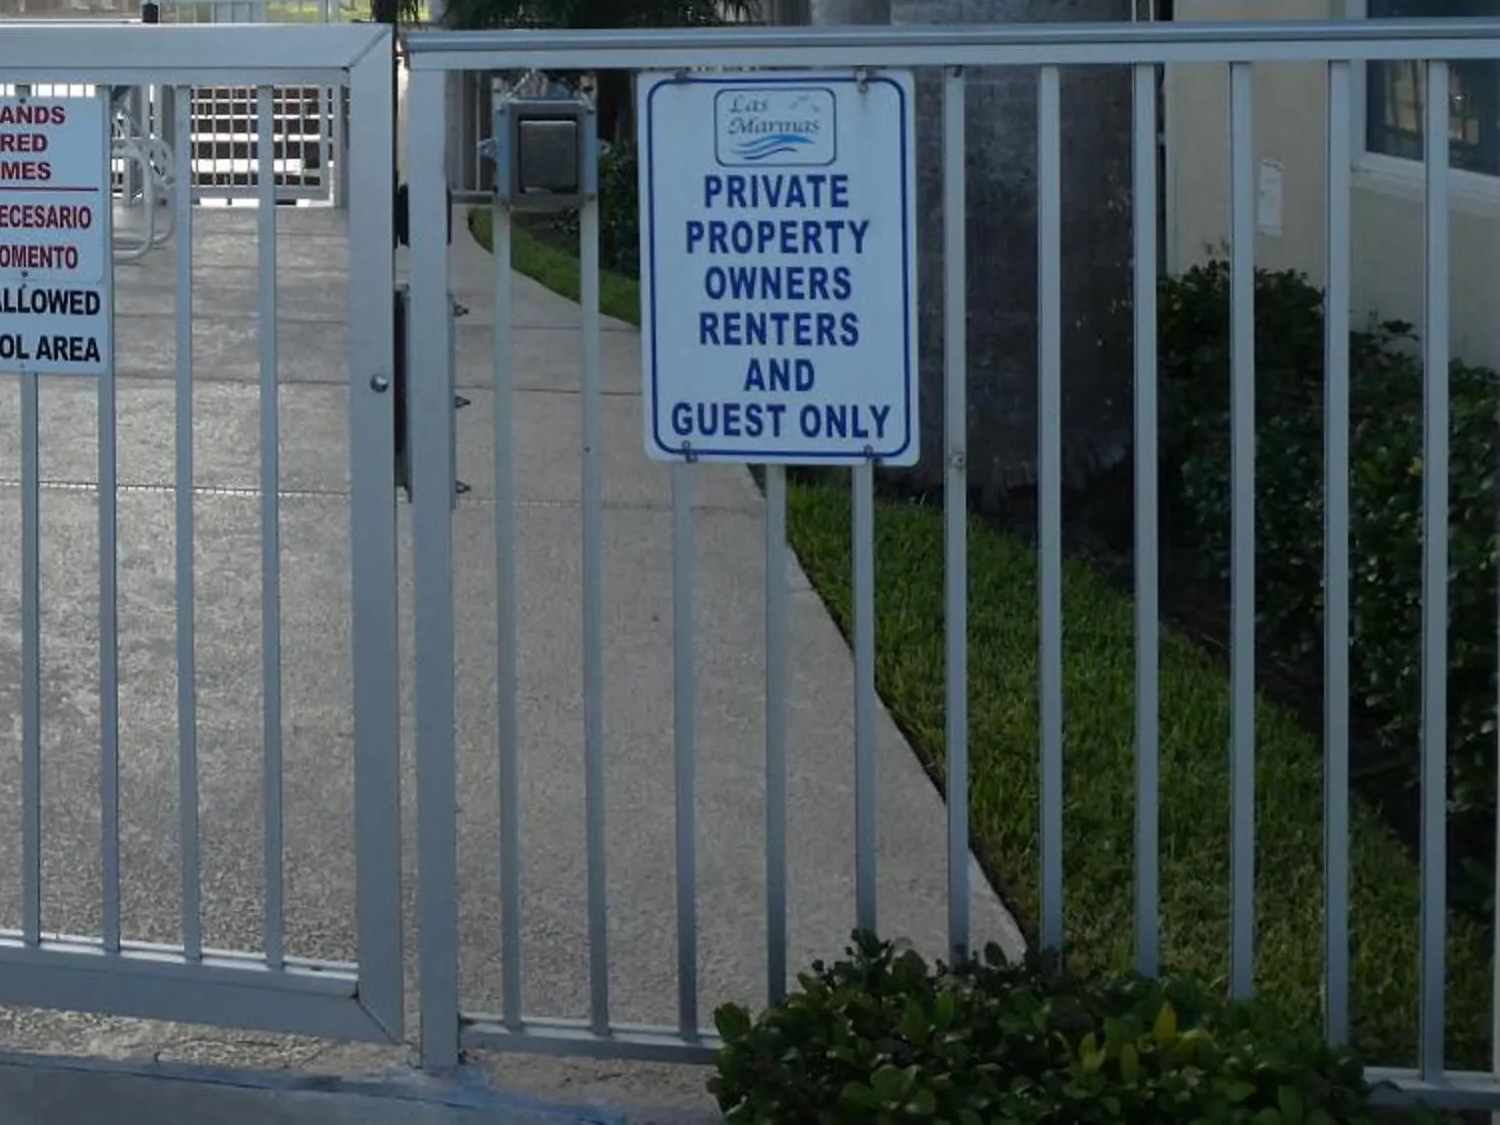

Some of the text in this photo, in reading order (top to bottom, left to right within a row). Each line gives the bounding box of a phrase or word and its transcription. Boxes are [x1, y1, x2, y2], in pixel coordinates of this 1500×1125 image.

[728, 93, 769, 114] Las
[704, 174, 849, 209] PRIVATE
[686, 220, 870, 254] PROPERTY
[705, 266, 852, 301] OWNERS
[699, 312, 859, 347] RENTERS
[35, 335, 101, 363] AREA
[743, 358, 815, 392] AND
[671, 402, 891, 439] GUEST ONLY
